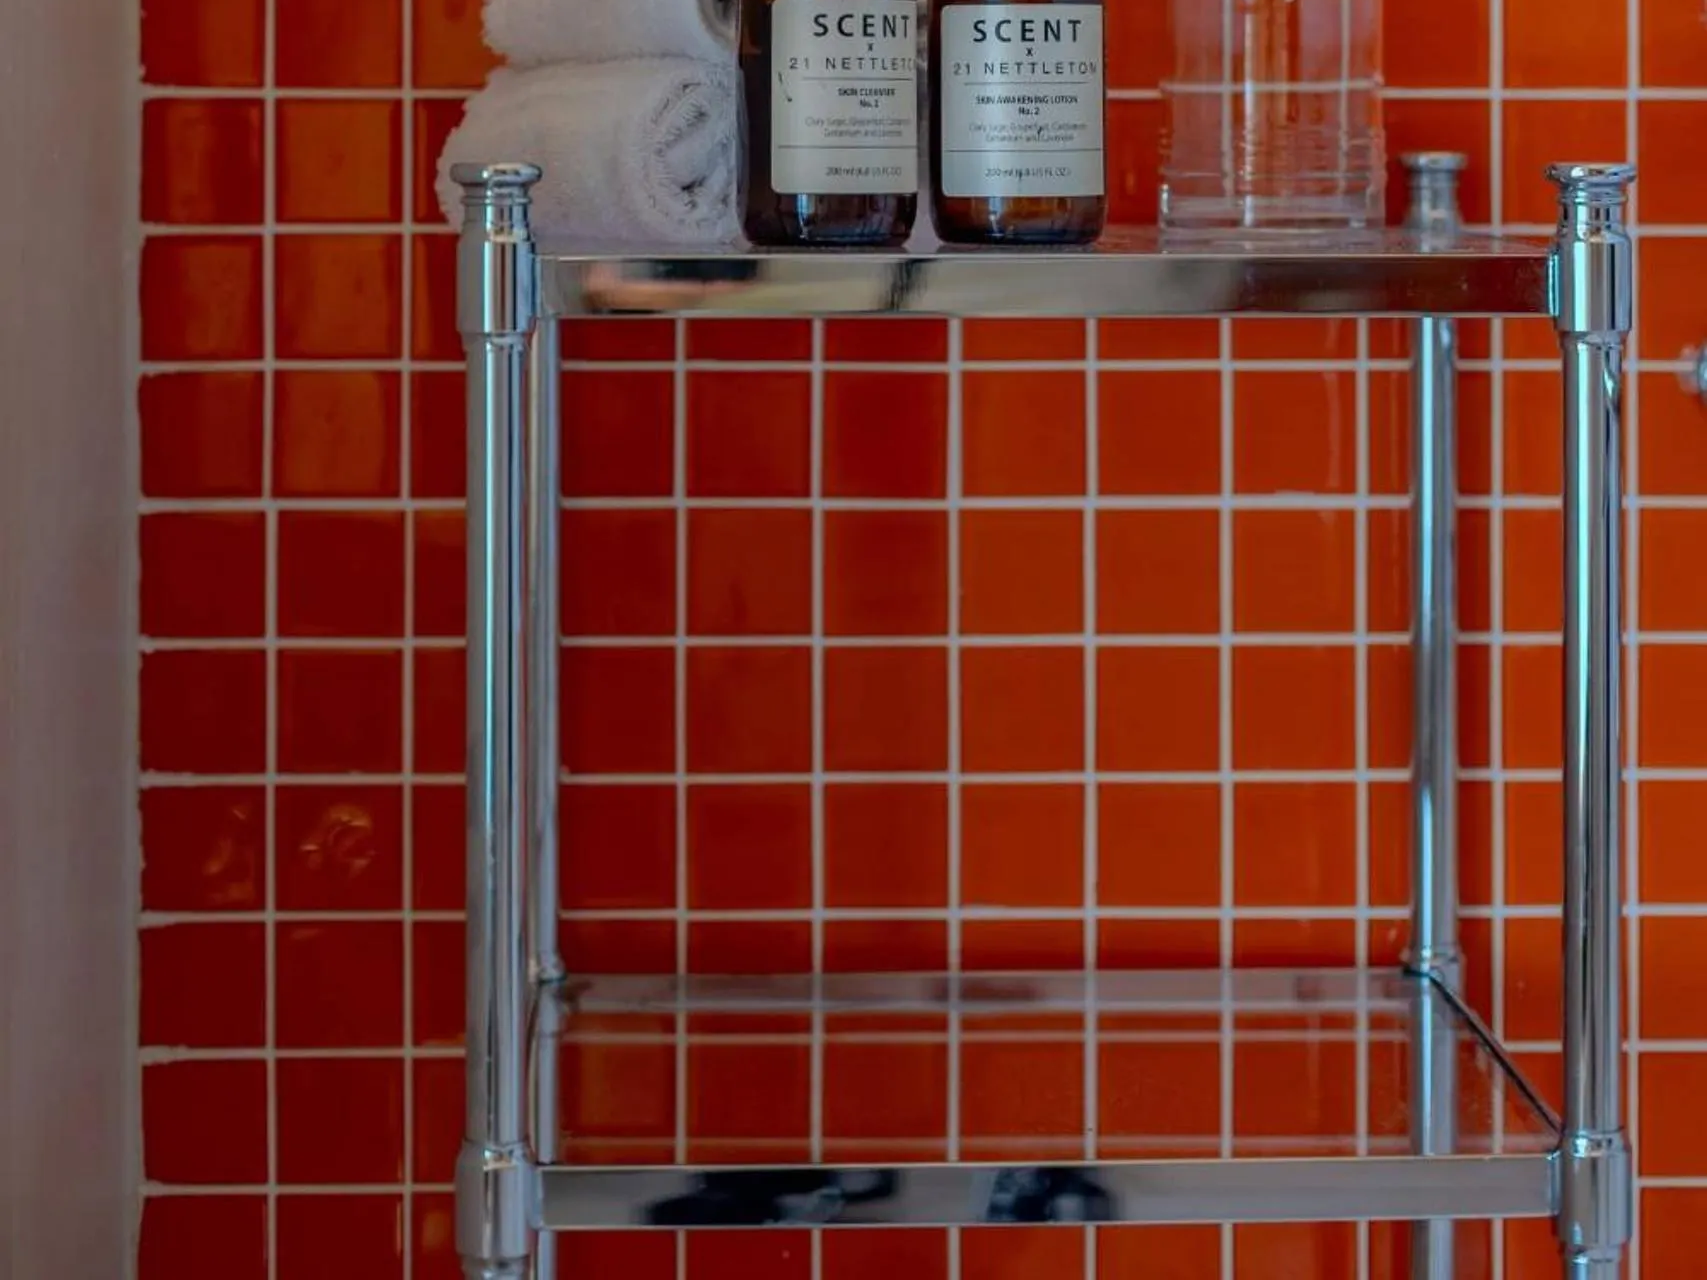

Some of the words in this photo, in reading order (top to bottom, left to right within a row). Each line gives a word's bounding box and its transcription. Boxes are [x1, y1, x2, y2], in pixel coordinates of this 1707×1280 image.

[813, 13, 910, 38] SCENT
[973, 19, 1081, 42] SCENT
[789, 57, 809, 71] 21
[953, 62, 970, 76] 21
[984, 61, 1097, 75] NETTLETON
[838, 87, 858, 97] SKIN
[975, 95, 995, 105] SKIN
[996, 95, 1049, 105] AWAKENING
[1050, 94, 1079, 105] LOTION
